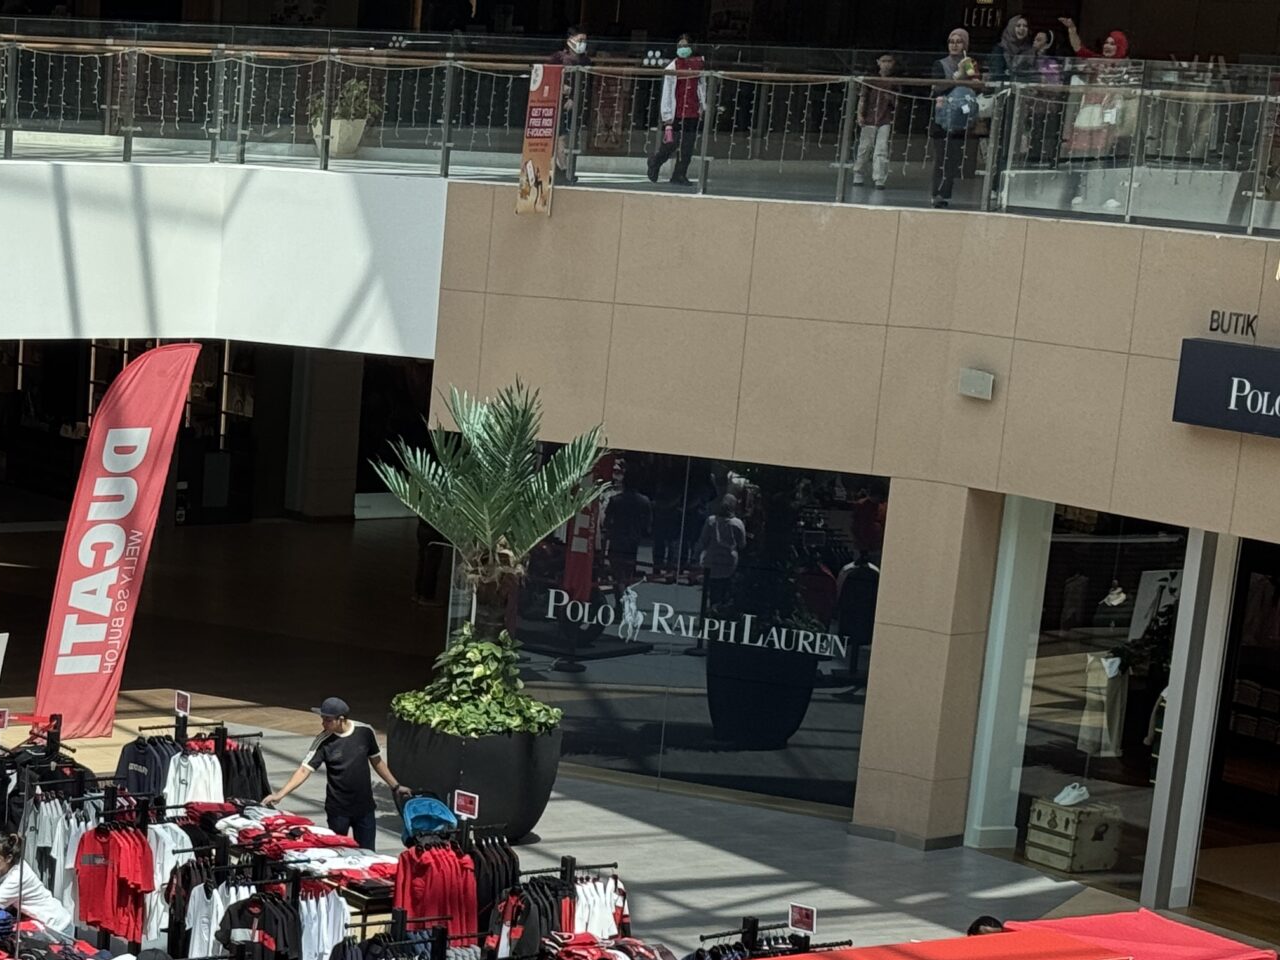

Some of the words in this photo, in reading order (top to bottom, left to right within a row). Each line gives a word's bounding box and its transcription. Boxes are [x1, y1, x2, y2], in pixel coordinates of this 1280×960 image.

[1209, 309, 1259, 337] BUTIK
[545, 588, 615, 626] POLO
[650, 602, 739, 643] RALPH
[741, 613, 850, 658] LAUREN
